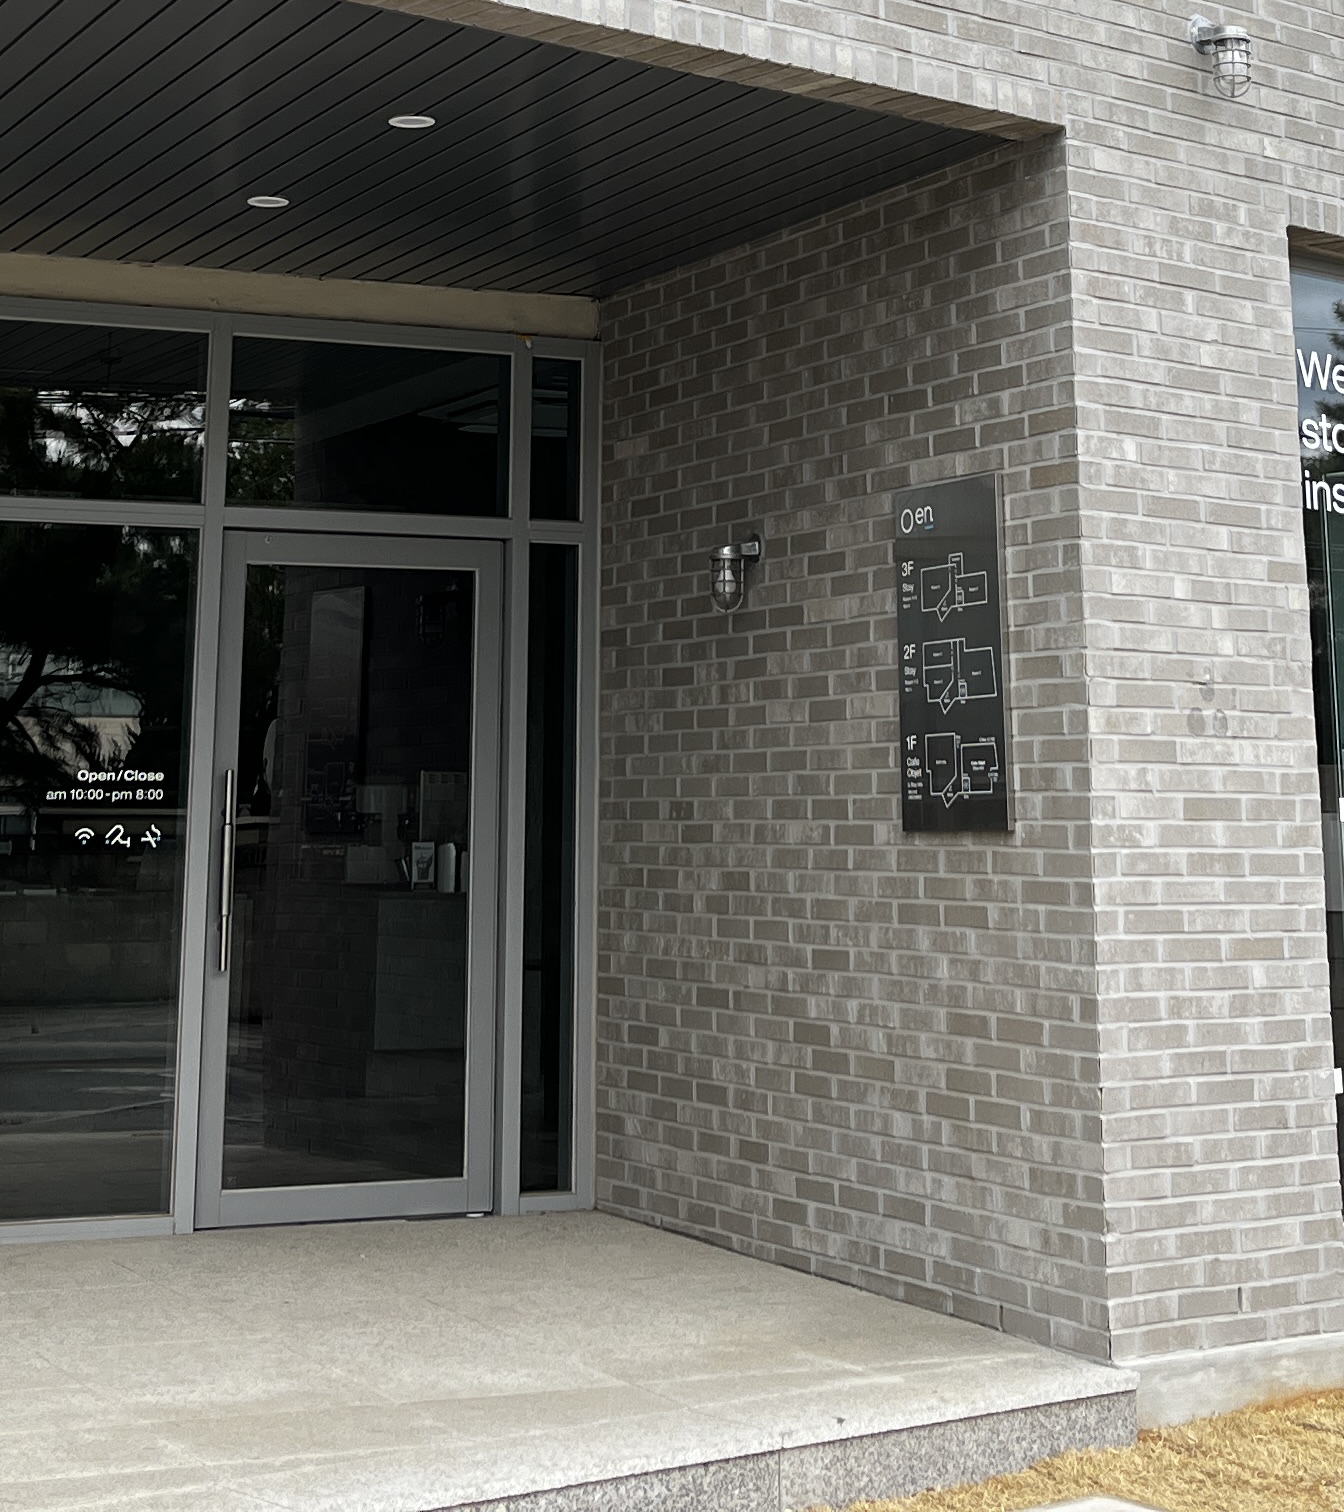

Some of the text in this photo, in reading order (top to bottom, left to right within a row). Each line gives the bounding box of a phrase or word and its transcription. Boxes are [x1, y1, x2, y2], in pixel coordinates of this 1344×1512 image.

[902, 561, 914, 576] 3F
[903, 643, 916, 660] 2F
[906, 735, 917, 750] 1F
[46, 790, 67, 801] am
[135, 788, 164, 801] 8:00
